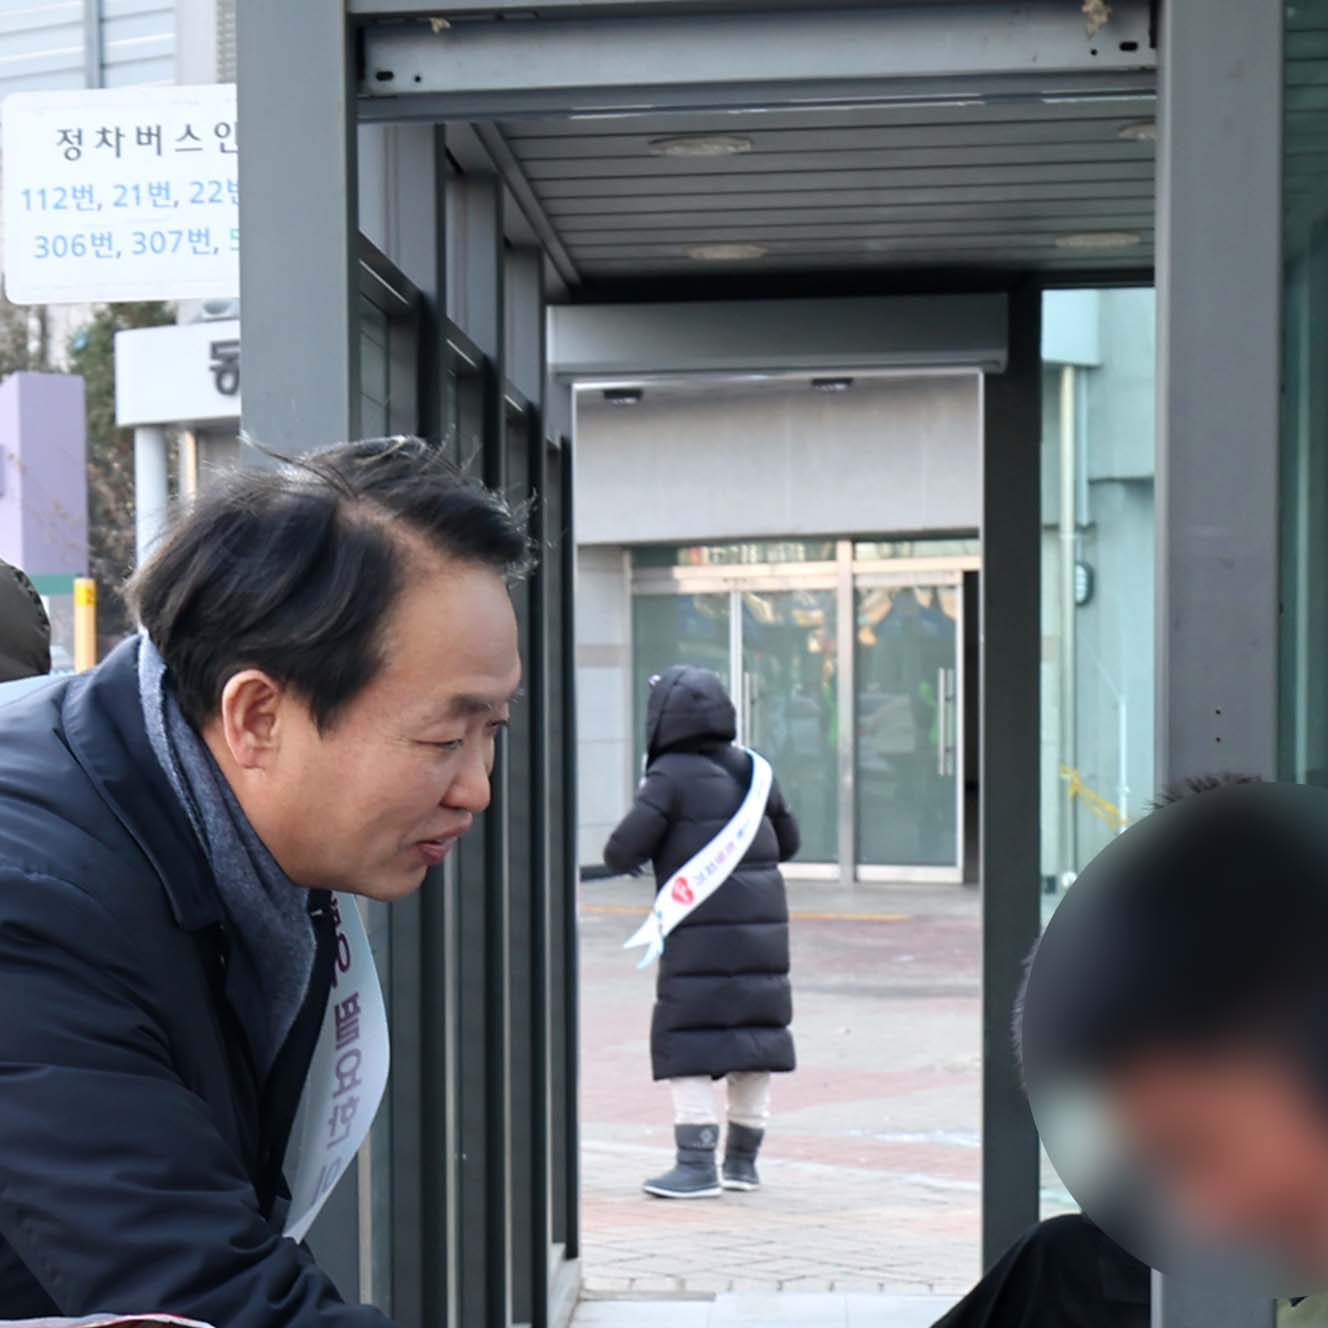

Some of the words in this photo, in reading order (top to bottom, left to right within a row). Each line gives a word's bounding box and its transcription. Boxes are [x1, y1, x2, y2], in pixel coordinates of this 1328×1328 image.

[21, 185, 103, 212] 112번,
[113, 181, 179, 209] 21번,
[34, 230, 122, 260] 306번,
[131, 227, 219, 257] 307번,
